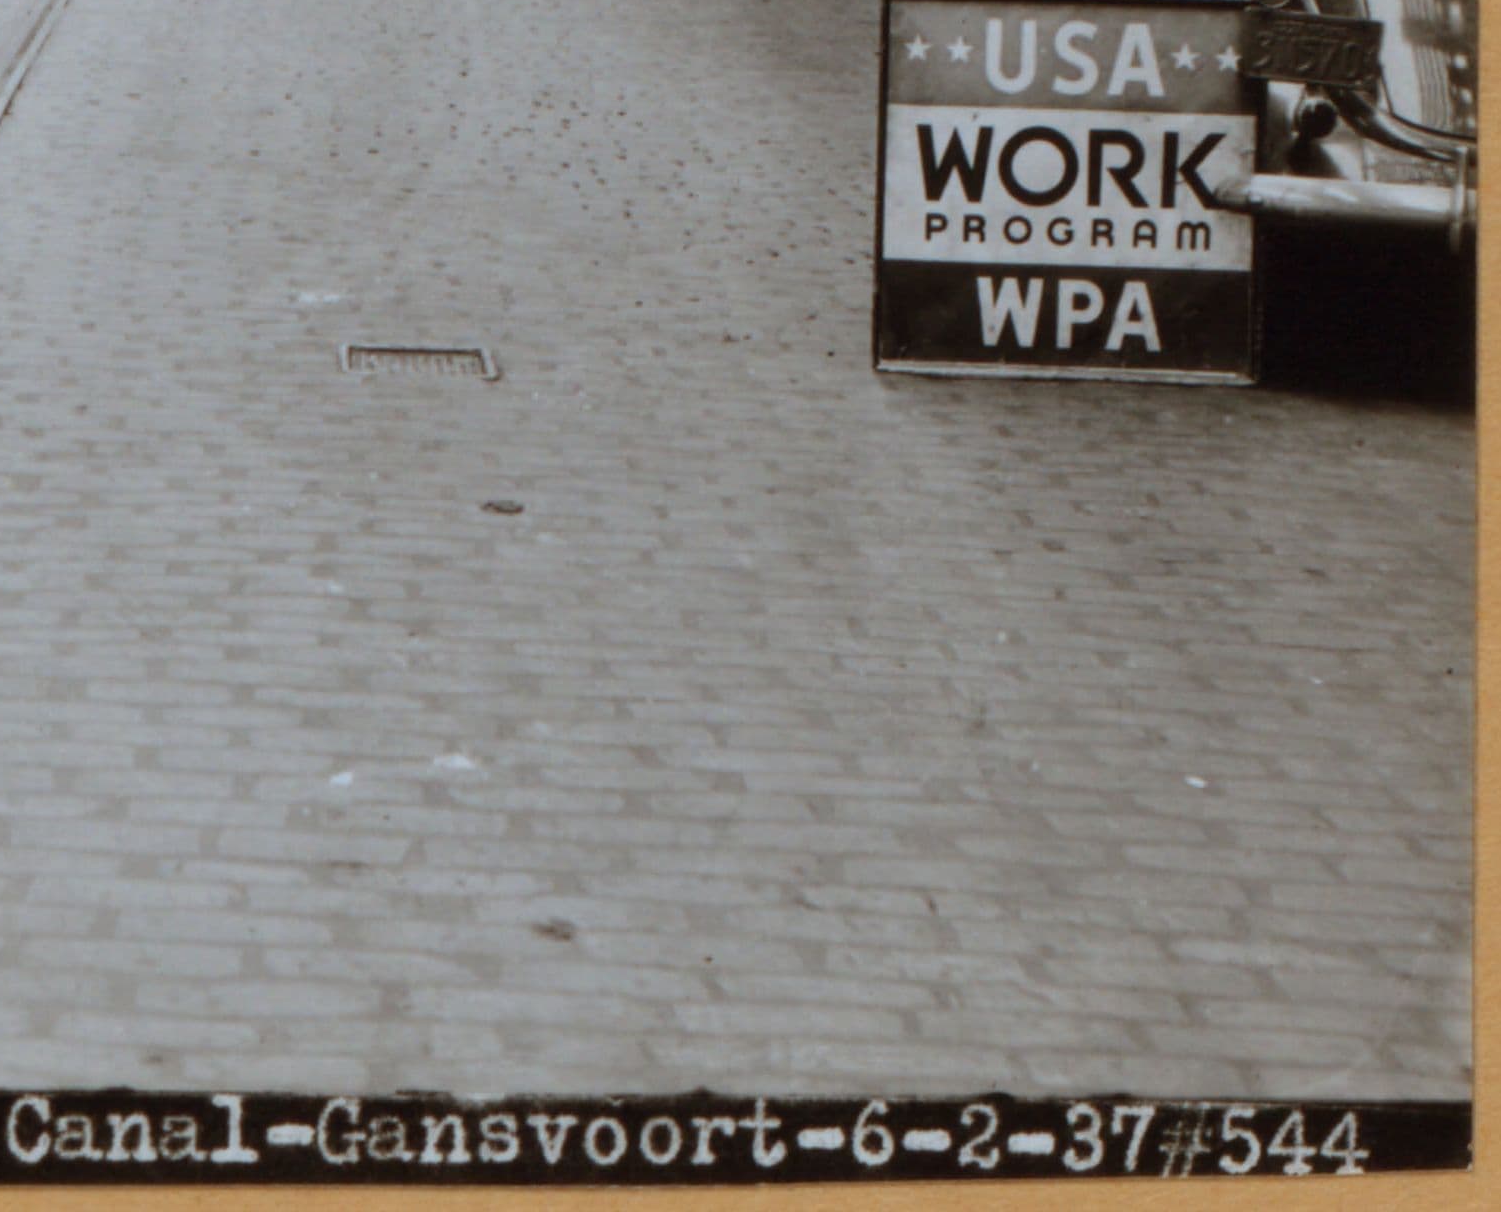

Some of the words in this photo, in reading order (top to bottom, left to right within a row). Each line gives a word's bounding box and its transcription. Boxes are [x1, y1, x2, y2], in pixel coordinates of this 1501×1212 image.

[984, 17, 1166, 97] USA
[915, 123, 1229, 211] WORK
[924, 212, 1212, 251] PROGRAM
[976, 275, 1162, 352] WPA
